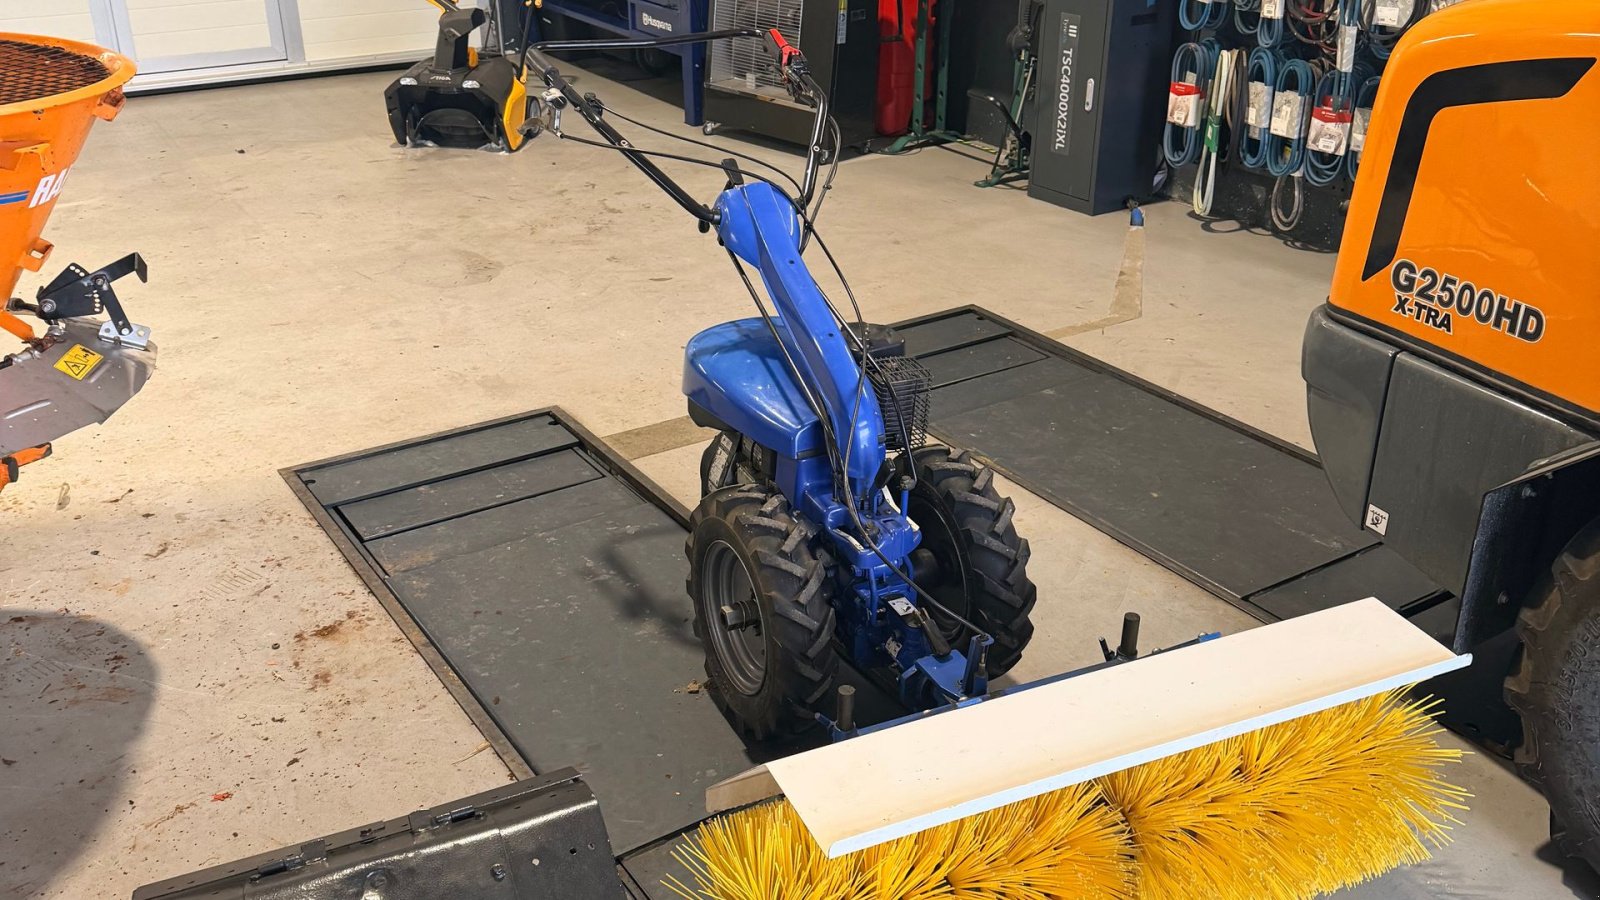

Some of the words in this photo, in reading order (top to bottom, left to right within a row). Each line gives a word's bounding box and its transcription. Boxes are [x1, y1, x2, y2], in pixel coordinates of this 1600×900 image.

[1055, 48, 1073, 150] TSC4000X2iXL
[28, 164, 73, 209] RA
[1391, 259, 1545, 343] G2500HD
[1391, 292, 1453, 335] X-TRA
